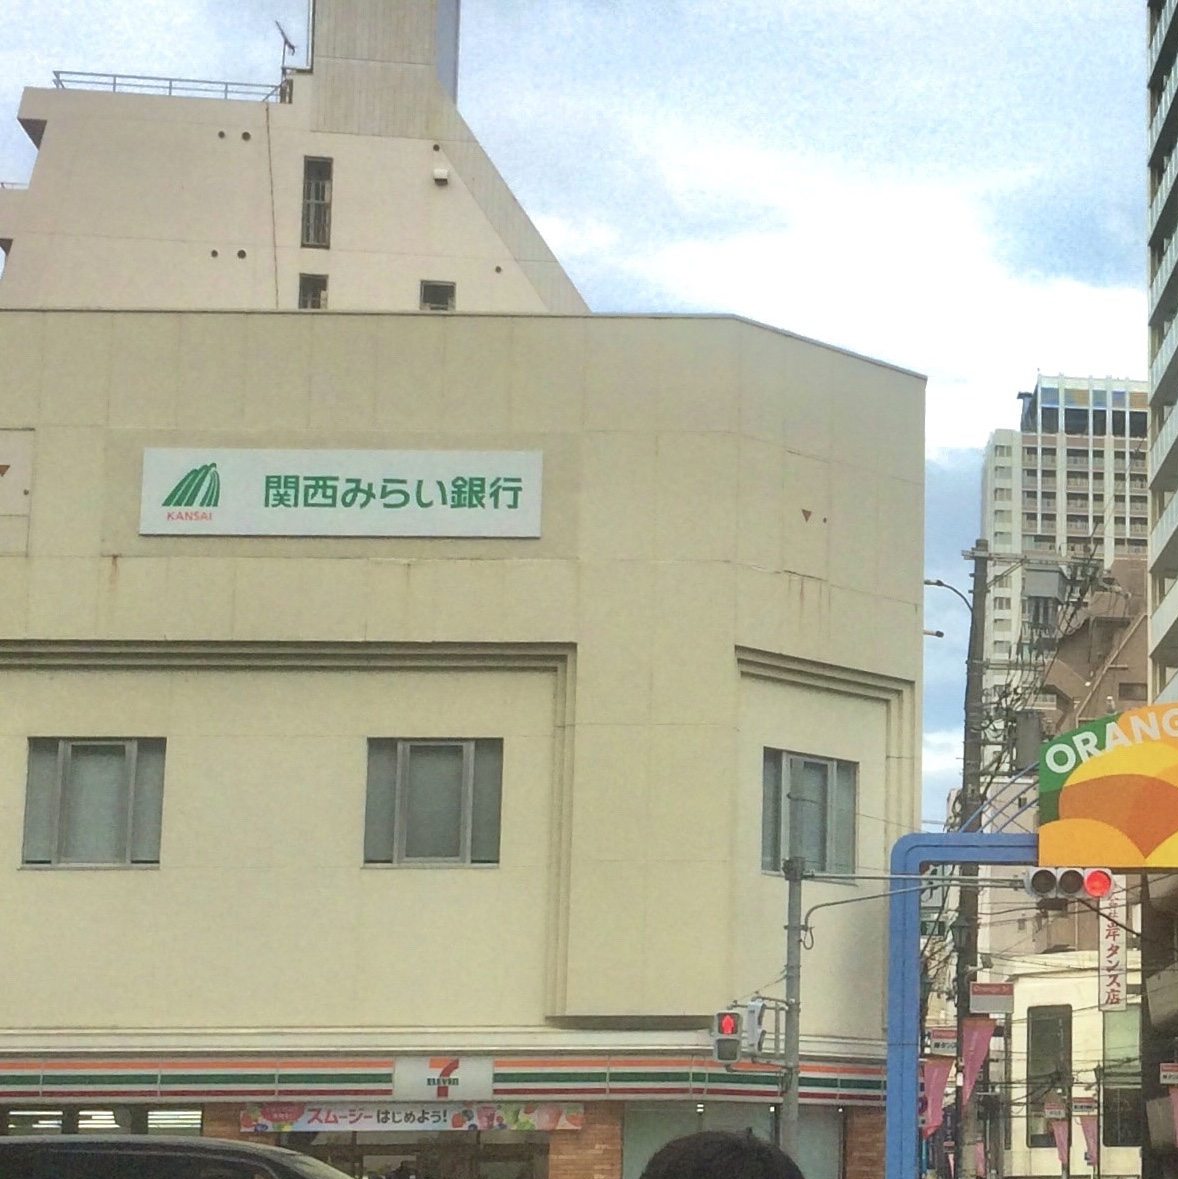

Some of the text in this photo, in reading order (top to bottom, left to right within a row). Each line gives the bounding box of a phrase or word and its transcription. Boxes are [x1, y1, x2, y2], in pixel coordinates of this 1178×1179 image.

[264, 474, 523, 510] 関西みらい銀行
[166, 512, 213, 521] KANSAI
